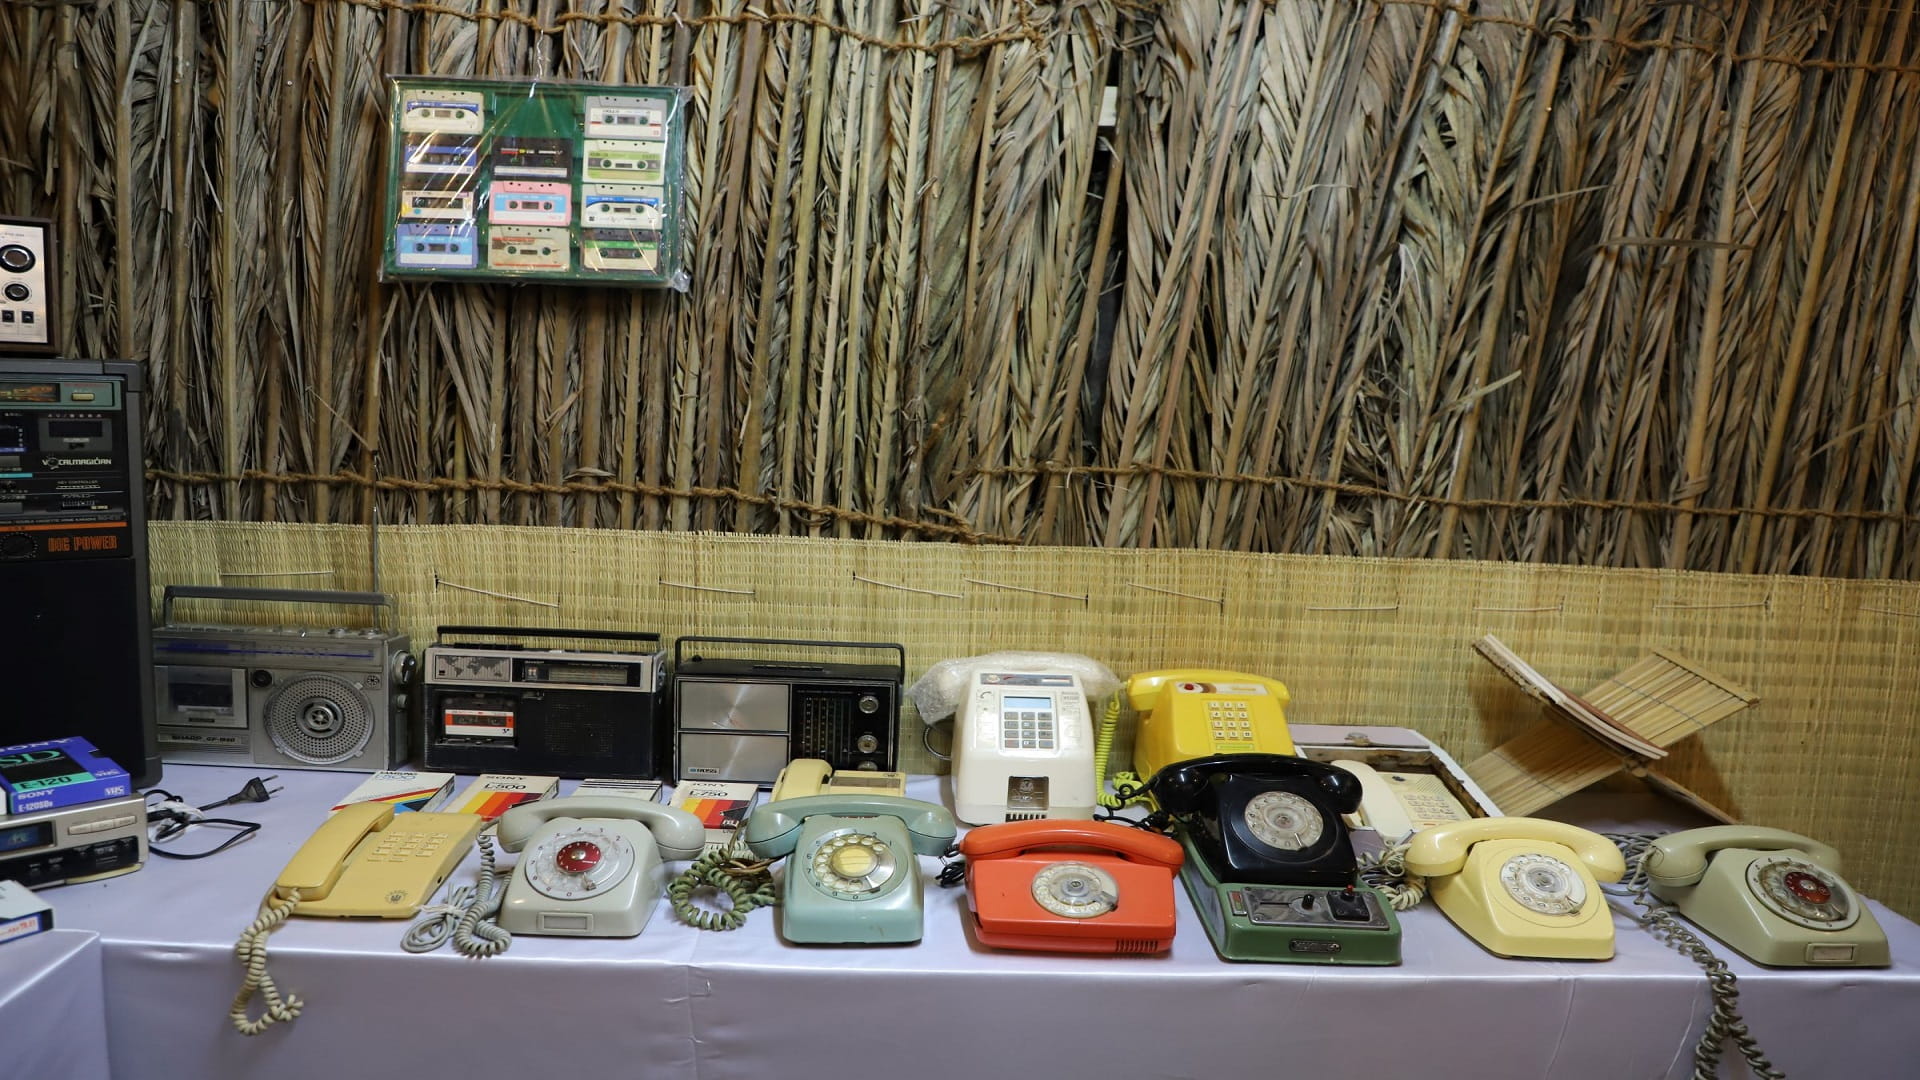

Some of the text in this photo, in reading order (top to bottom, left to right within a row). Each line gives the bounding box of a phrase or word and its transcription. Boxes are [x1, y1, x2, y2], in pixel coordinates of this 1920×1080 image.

[19, 775, 73, 789] E-120
[17, 788, 55, 800] SONY
[105, 786, 125, 796] VHS
